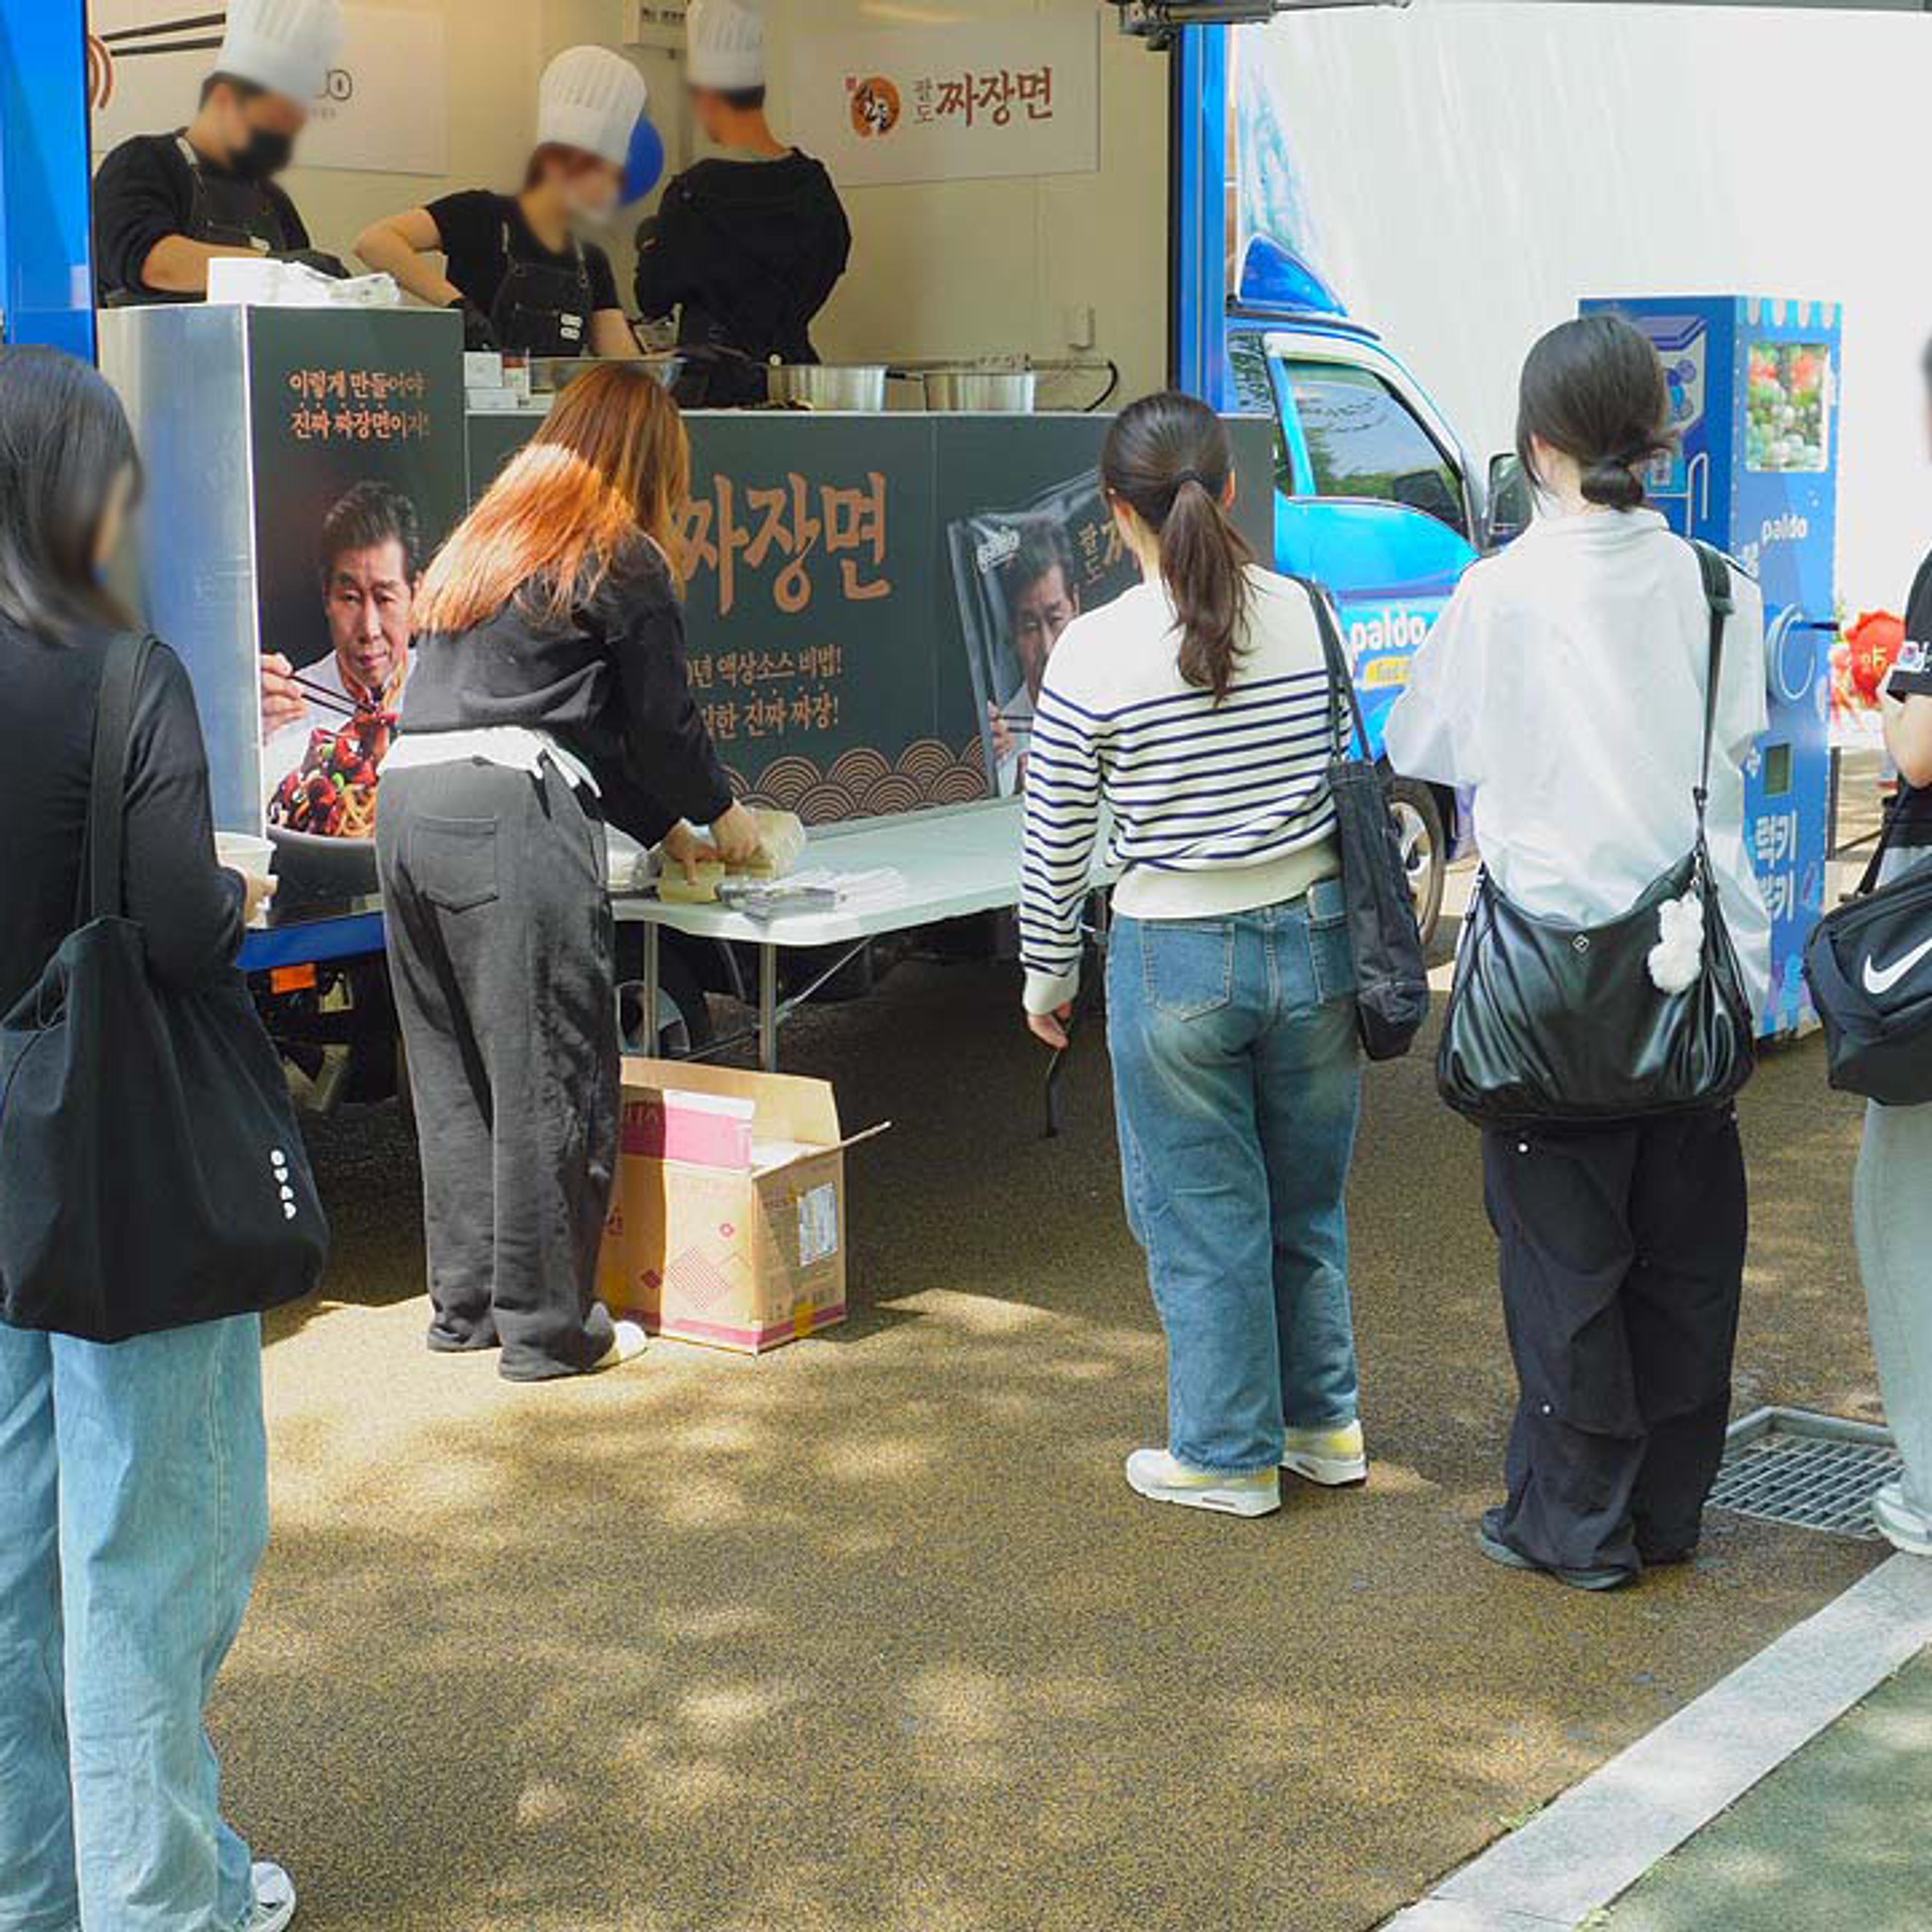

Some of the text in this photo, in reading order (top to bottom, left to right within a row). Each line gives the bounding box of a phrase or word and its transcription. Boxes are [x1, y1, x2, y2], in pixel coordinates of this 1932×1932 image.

[936, 65, 1053, 127] 짜장면
[289, 369, 426, 398] 이렇게 만들어야
[290, 410, 330, 439] 진짜
[673, 472, 892, 615] 짜장면
[1762, 514, 1808, 546] paldo
[1352, 607, 1426, 654] paldo
[716, 651, 795, 687] 액상소스
[799, 643, 842, 679] 비법!
[743, 696, 788, 736] 진짜
[791, 691, 838, 730] 짜장!
[1756, 809, 1797, 869] 럭키
